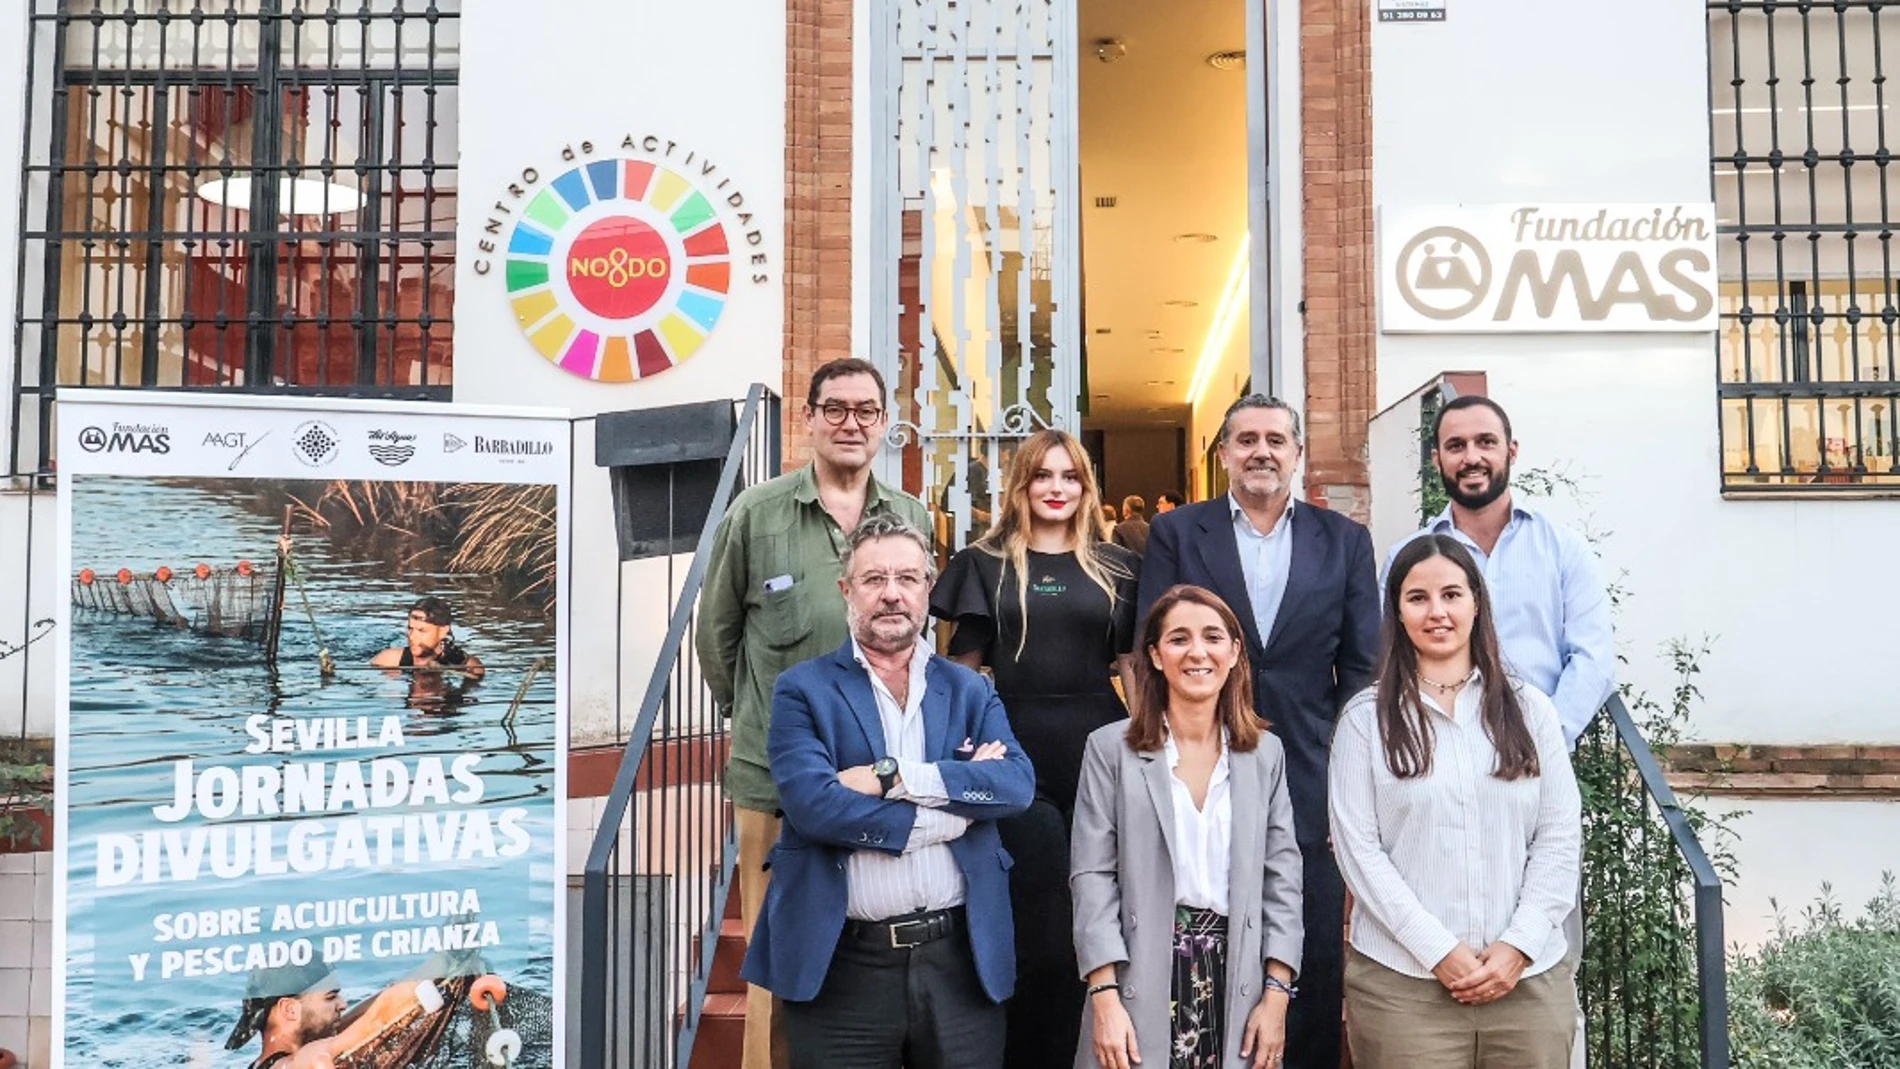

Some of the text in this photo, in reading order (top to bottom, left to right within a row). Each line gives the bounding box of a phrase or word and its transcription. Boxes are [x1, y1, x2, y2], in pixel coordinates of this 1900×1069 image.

[474, 133, 768, 285] CENTRO de ACTIVIDADES
[1510, 206, 1710, 243] Fundación
[1492, 247, 1714, 322] MAS
[107, 433, 170, 454] MAS
[112, 422, 169, 434] Fundación
[475, 436, 553, 455] BARBADILLO
[245, 713, 405, 754] SEVILLA
[152, 753, 485, 823] JORNADAS
[96, 807, 531, 888] DIVULGATIVAS
[152, 888, 481, 943] SOBRE ACUICULTURA
[128, 920, 501, 981] Y PESCADO DE CRIANZA
